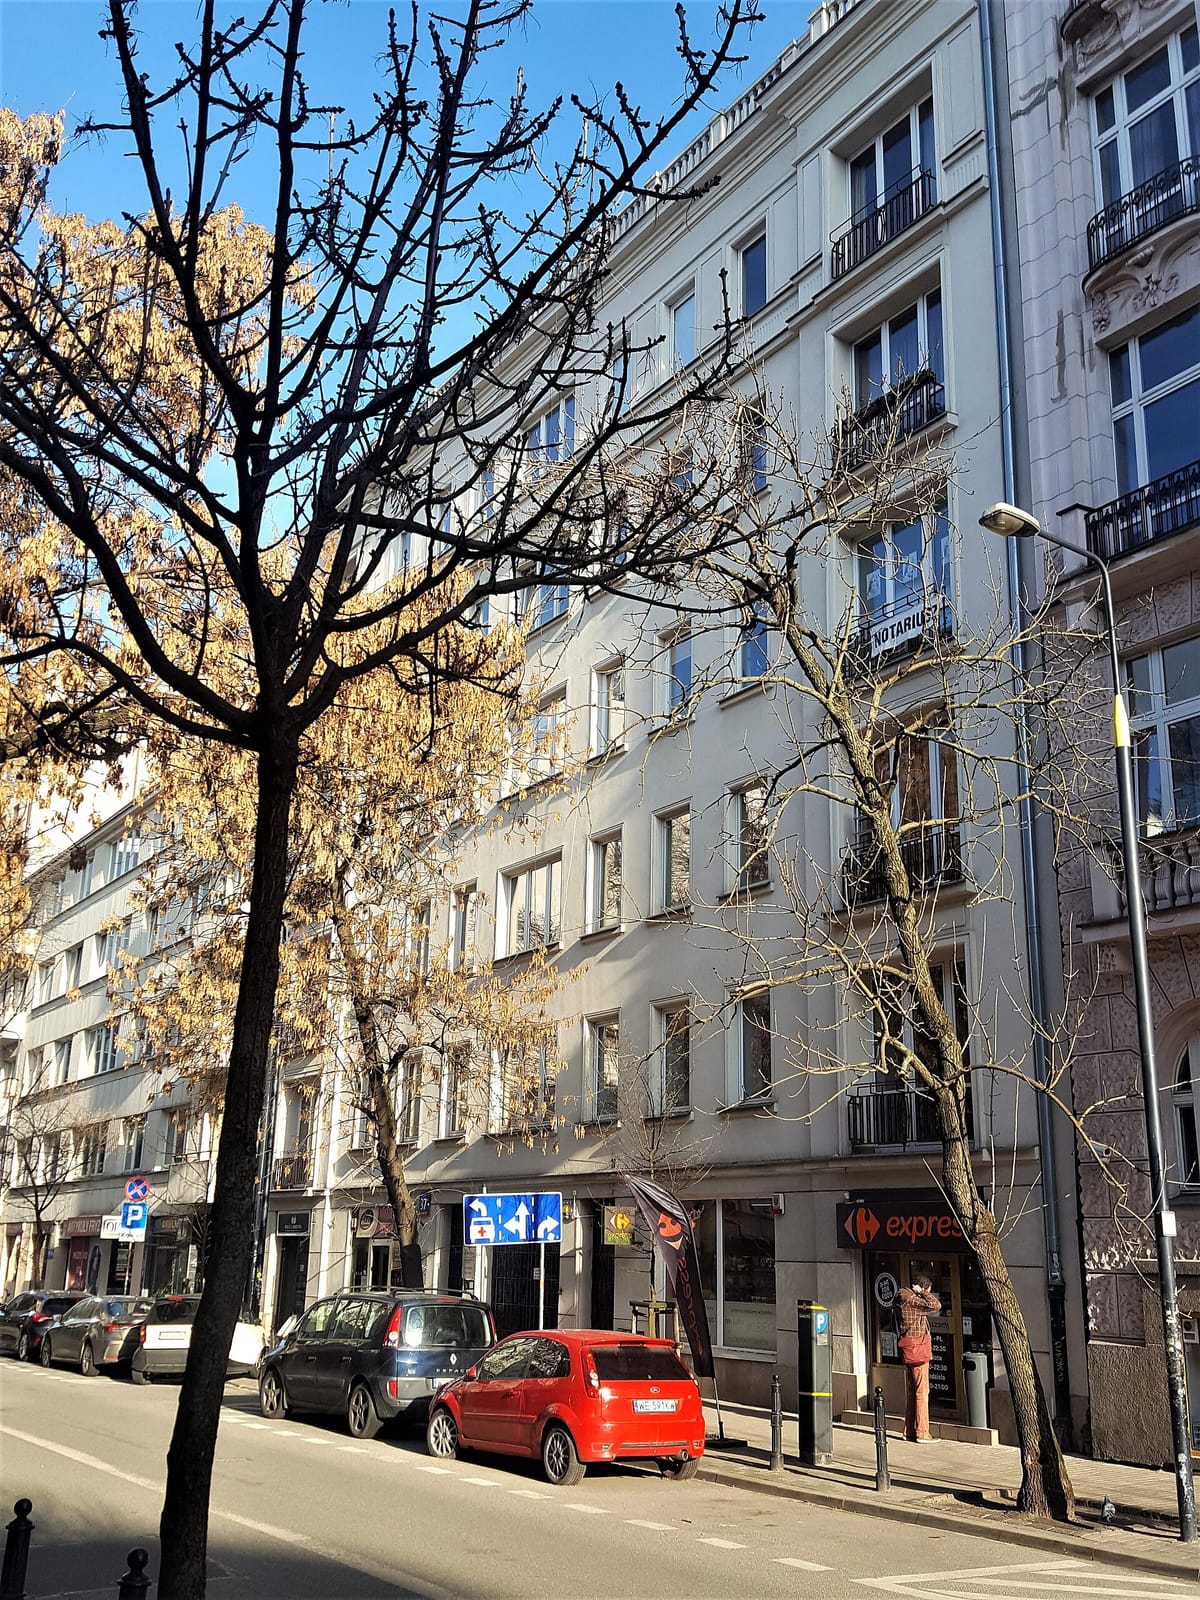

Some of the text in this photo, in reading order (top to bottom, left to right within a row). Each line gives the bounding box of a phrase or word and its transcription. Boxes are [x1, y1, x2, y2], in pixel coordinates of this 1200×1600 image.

[126, 1205, 143, 1226] P
[886, 1215, 963, 1244] expres
[817, 1313, 825, 1329] P
